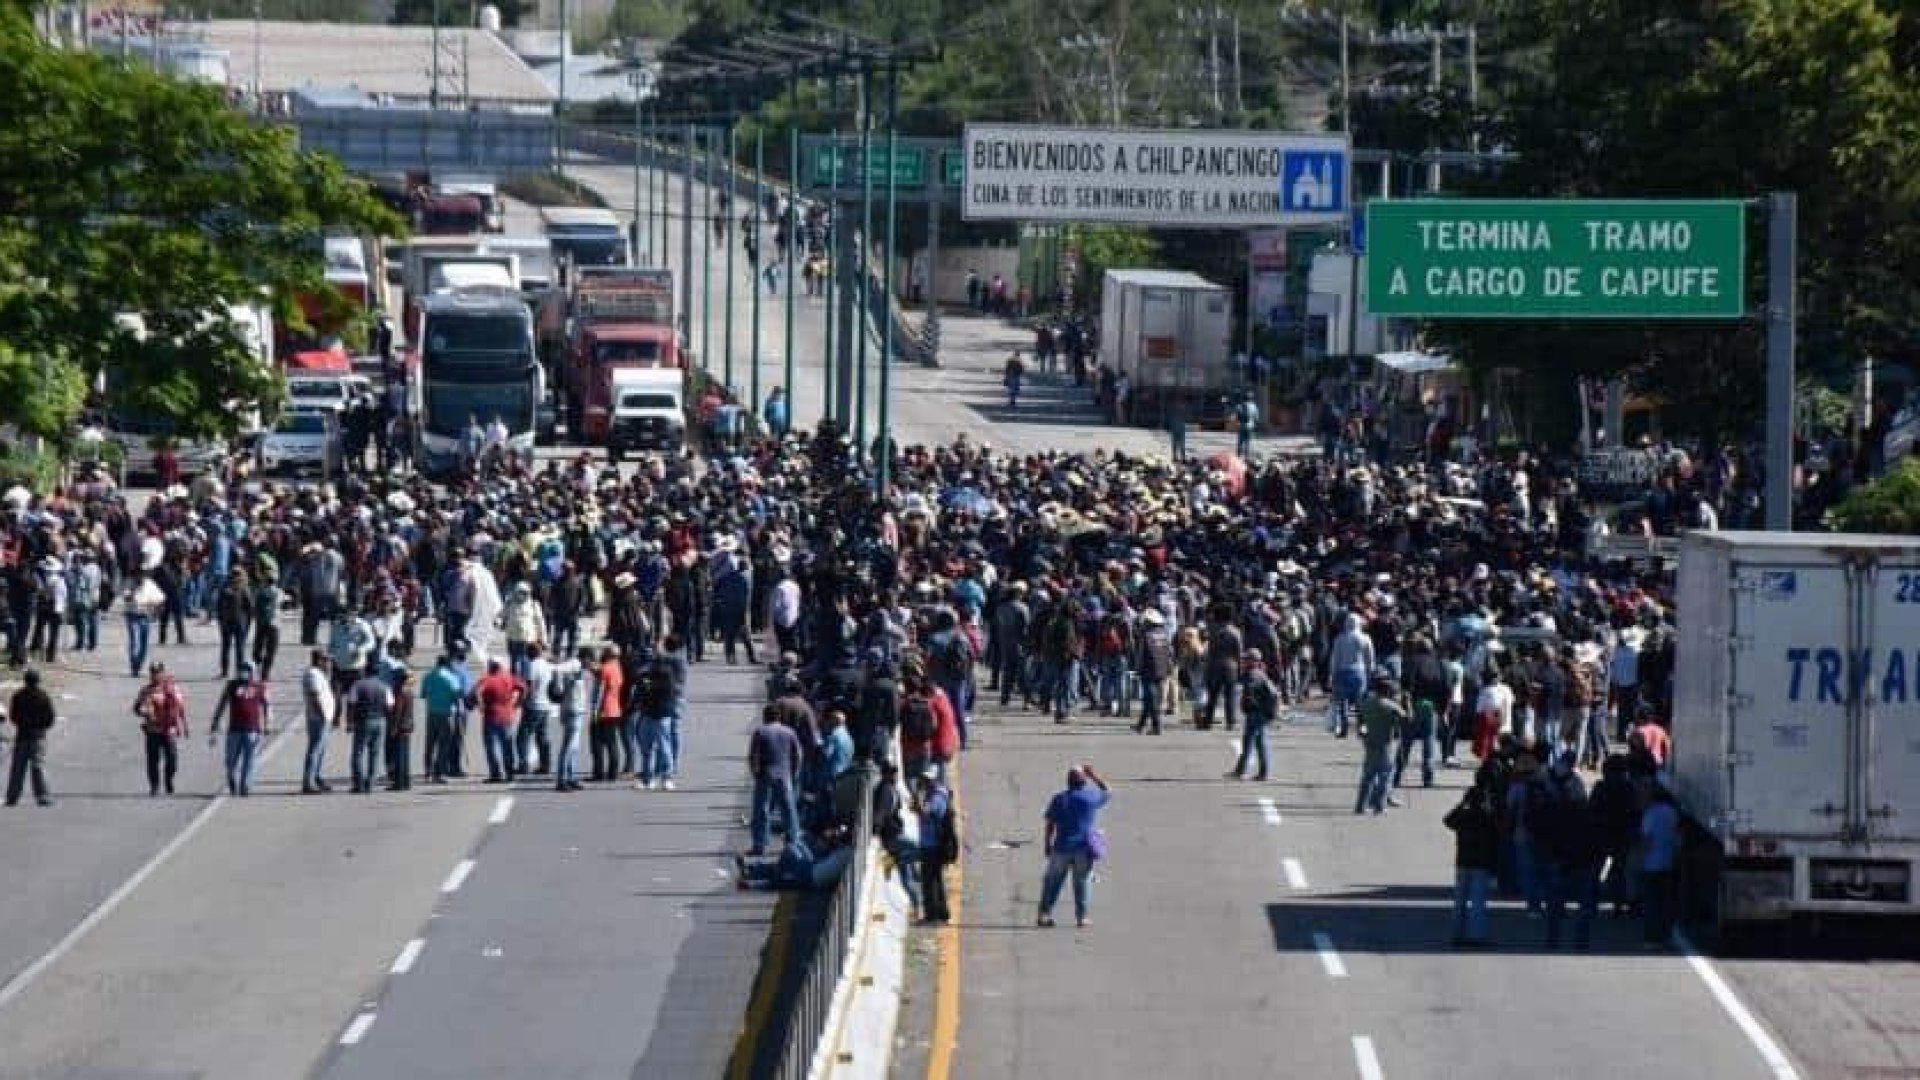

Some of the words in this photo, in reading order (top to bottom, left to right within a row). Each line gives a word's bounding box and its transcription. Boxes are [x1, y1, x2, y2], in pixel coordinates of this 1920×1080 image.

[973, 139, 1104, 171] BIENVENIDOS
[1113, 146, 1130, 172] A
[1135, 146, 1281, 178] CHILPANCINGO
[973, 184, 1010, 203] CUNA
[1016, 185, 1034, 205] DE
[1042, 185, 1068, 206] LOS
[1076, 187, 1173, 209] SENTIMIENTOS
[1179, 190, 1196, 209] DE
[1203, 190, 1223, 211] LA
[1228, 191, 1281, 213] NACION
[1418, 220, 1551, 251] TERMINA
[1584, 221, 1692, 251] TRAMO
[1389, 266, 1408, 296] A
[1425, 267, 1526, 297] CARGO
[1544, 267, 1582, 296] DE
[1602, 267, 1719, 297] CAPUFE
